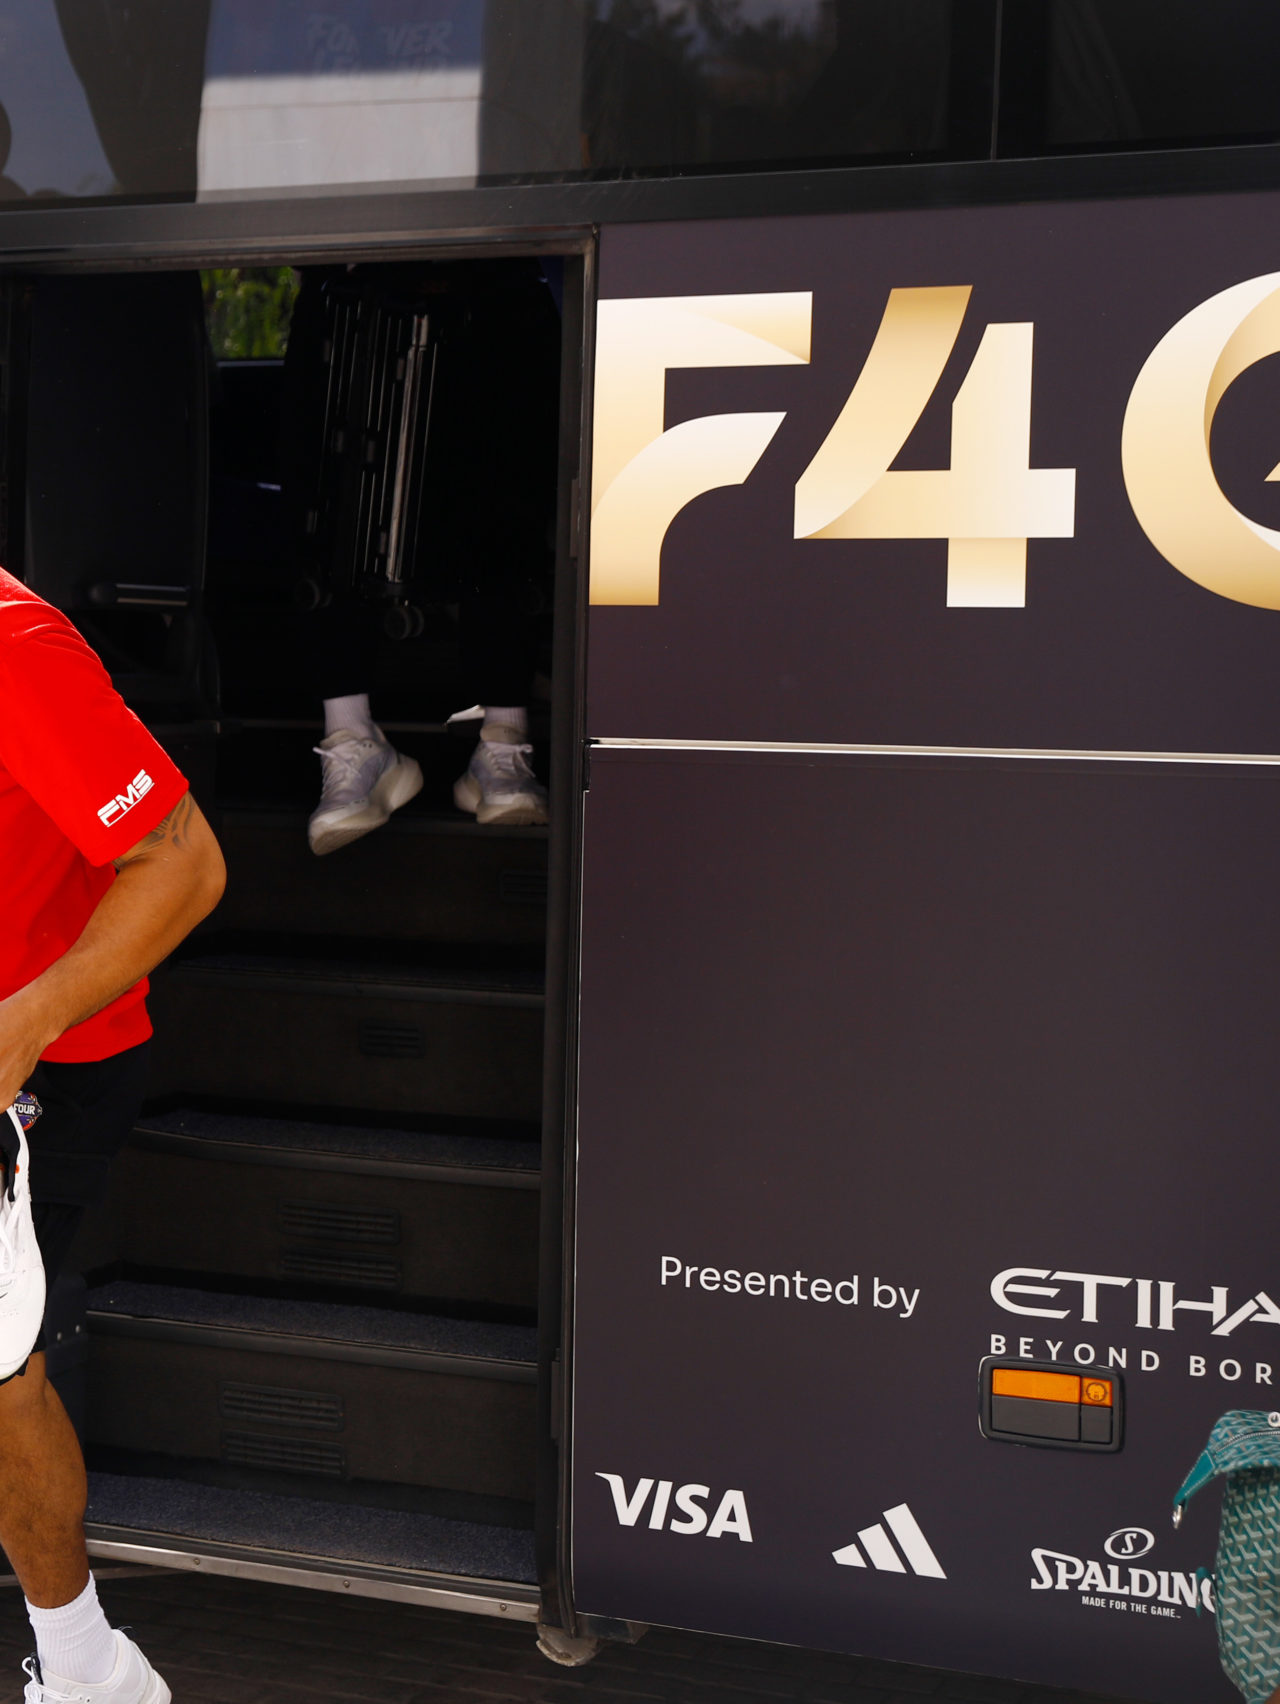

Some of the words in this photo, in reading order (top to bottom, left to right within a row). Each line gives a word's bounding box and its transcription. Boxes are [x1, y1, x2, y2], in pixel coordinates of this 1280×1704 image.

[306, 13, 454, 57] FOVER
[13, 1103, 36, 1115] FOUR
[661, 1255, 859, 1305] Presented
[873, 1277, 920, 1318] by
[990, 1267, 1280, 1336] ETIHA
[990, 1333, 1160, 1371] BEYOND
[1189, 1355, 1273, 1385] BOR
[594, 1471, 753, 1543] VISA
[1082, 1596, 1106, 1608] MADE
[1109, 1599, 1127, 1611] FOR
[1130, 1602, 1147, 1614] THE
